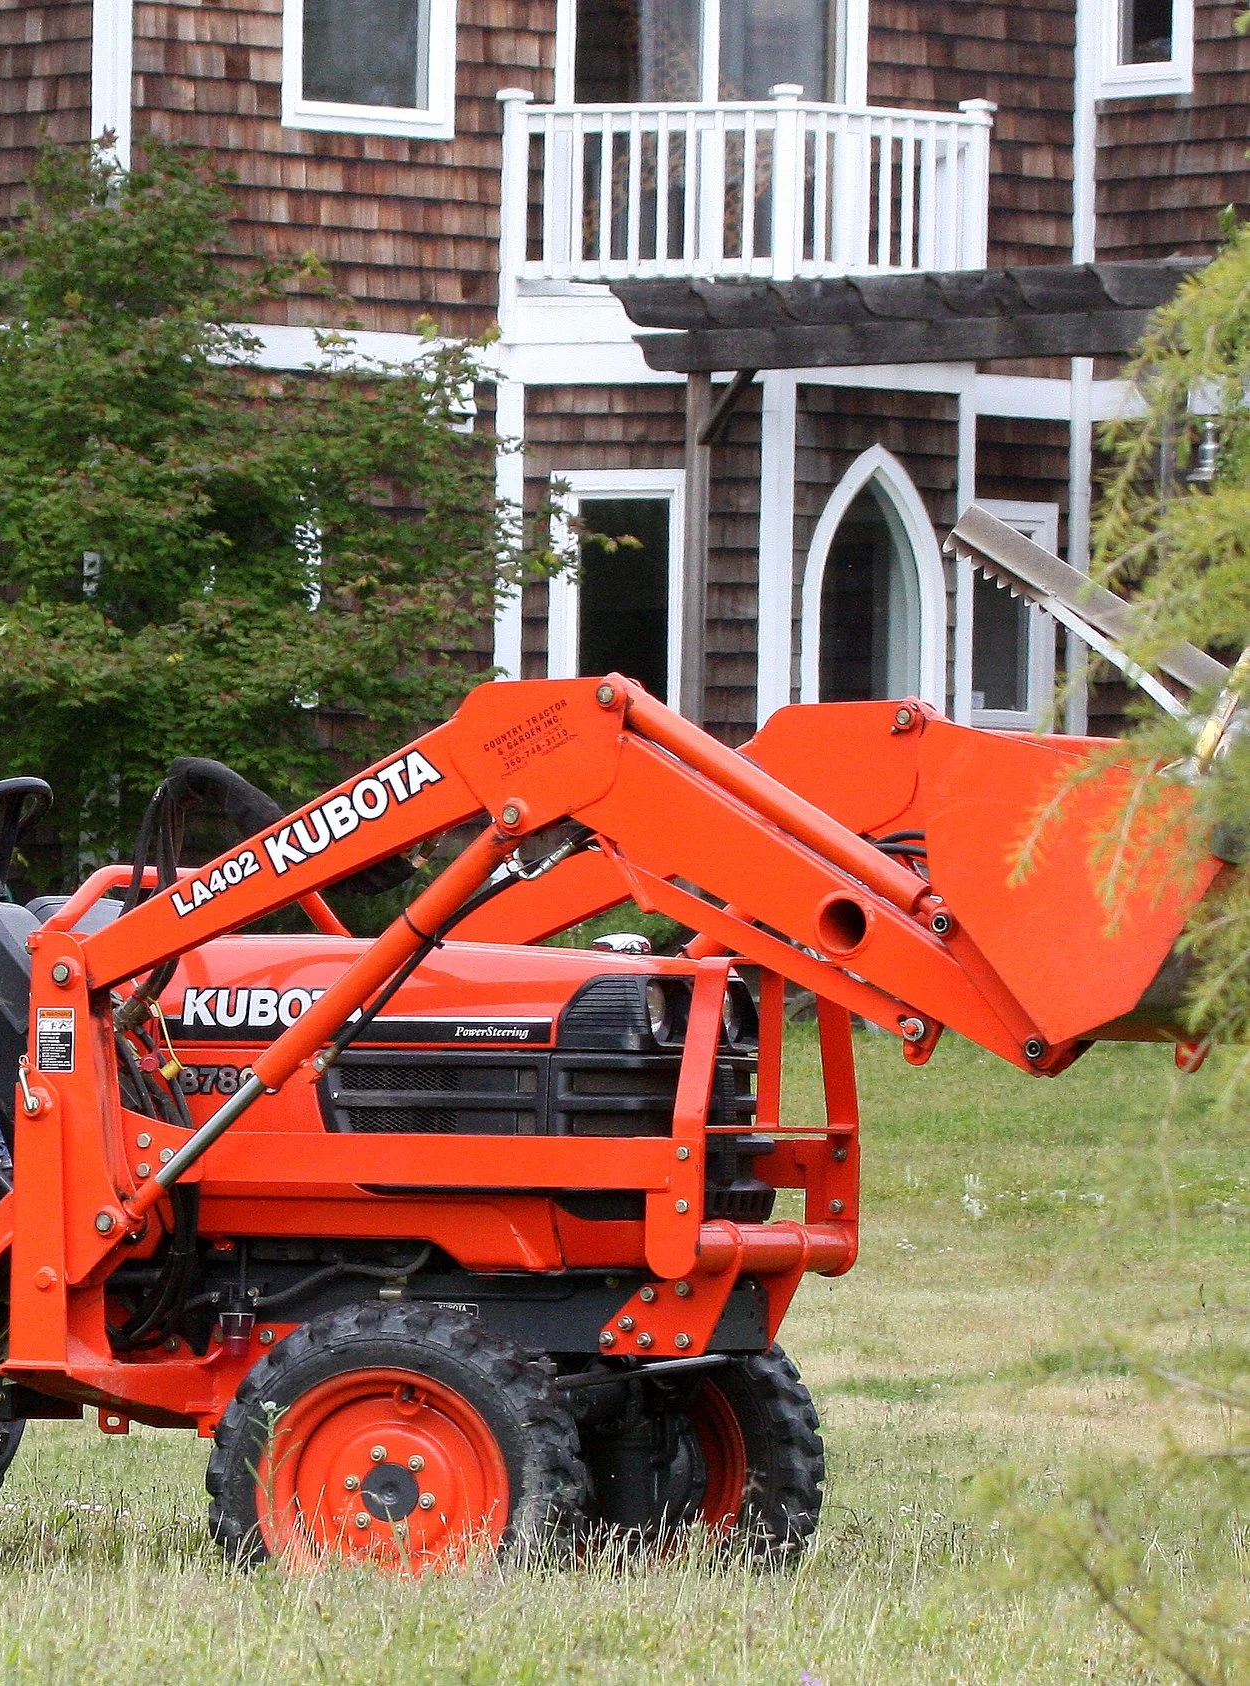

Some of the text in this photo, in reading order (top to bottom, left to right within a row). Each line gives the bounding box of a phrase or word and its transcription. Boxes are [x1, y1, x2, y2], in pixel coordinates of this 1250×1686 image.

[483, 699, 568, 752] COUNTRY TRACTOR
[506, 725, 542, 750] GARDEN
[171, 750, 444, 917] LA402 KUBOTA
[183, 988, 364, 1028] KUBO
[454, 1026, 530, 1040] PowerSteering
[178, 1066, 277, 1094] B78
